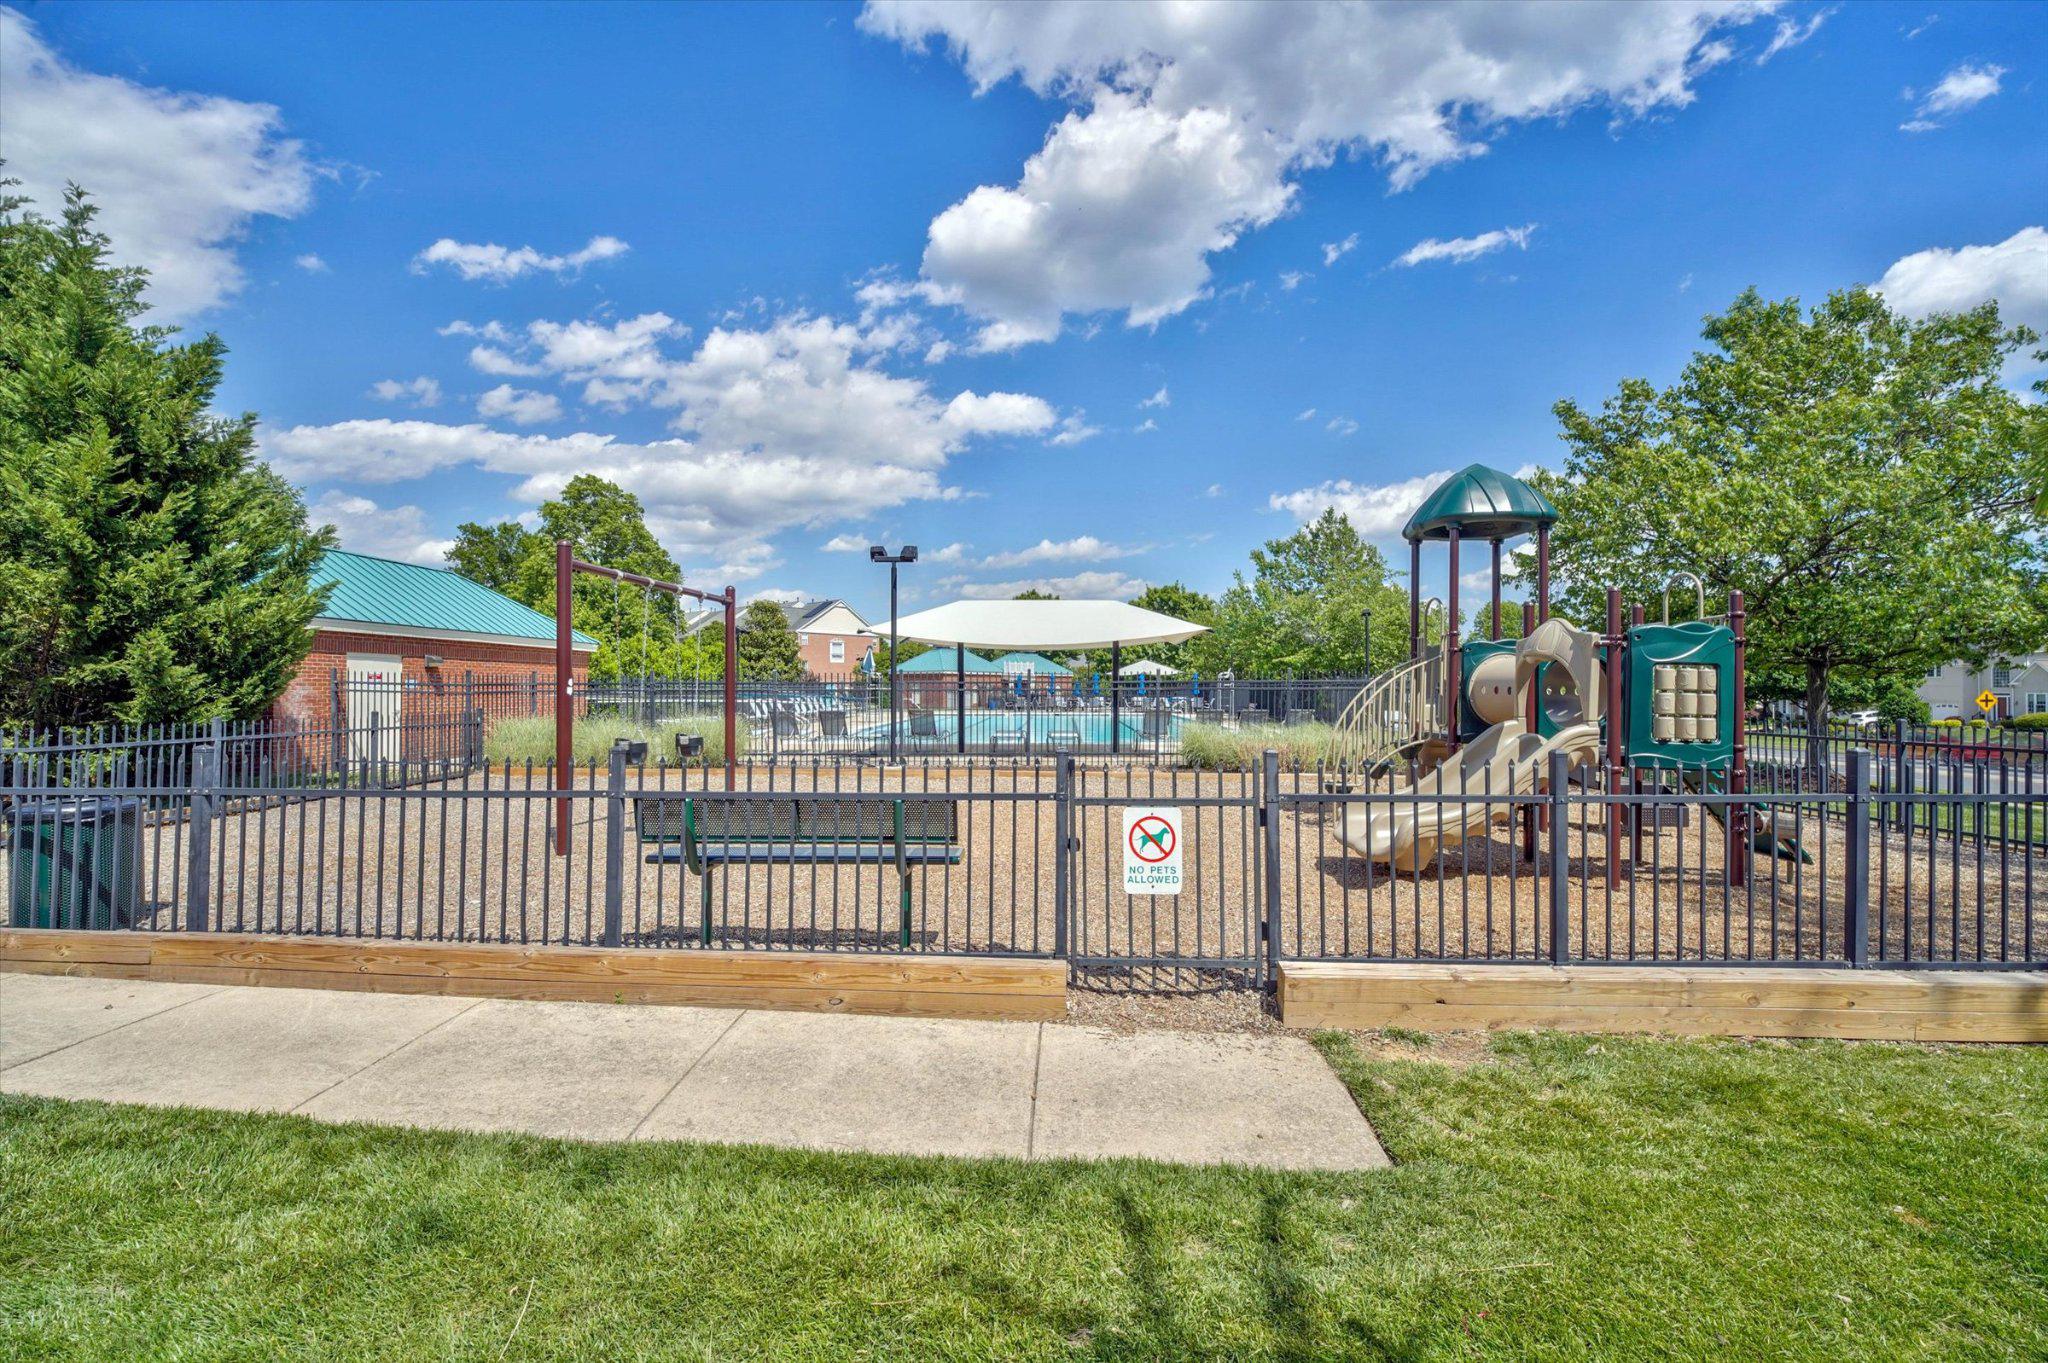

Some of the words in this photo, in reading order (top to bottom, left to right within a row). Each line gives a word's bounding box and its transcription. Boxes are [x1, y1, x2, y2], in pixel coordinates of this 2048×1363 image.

[1129, 866, 1144, 874] NO
[1150, 866, 1176, 874] PETS
[1127, 875, 1179, 884] ALLOWED
